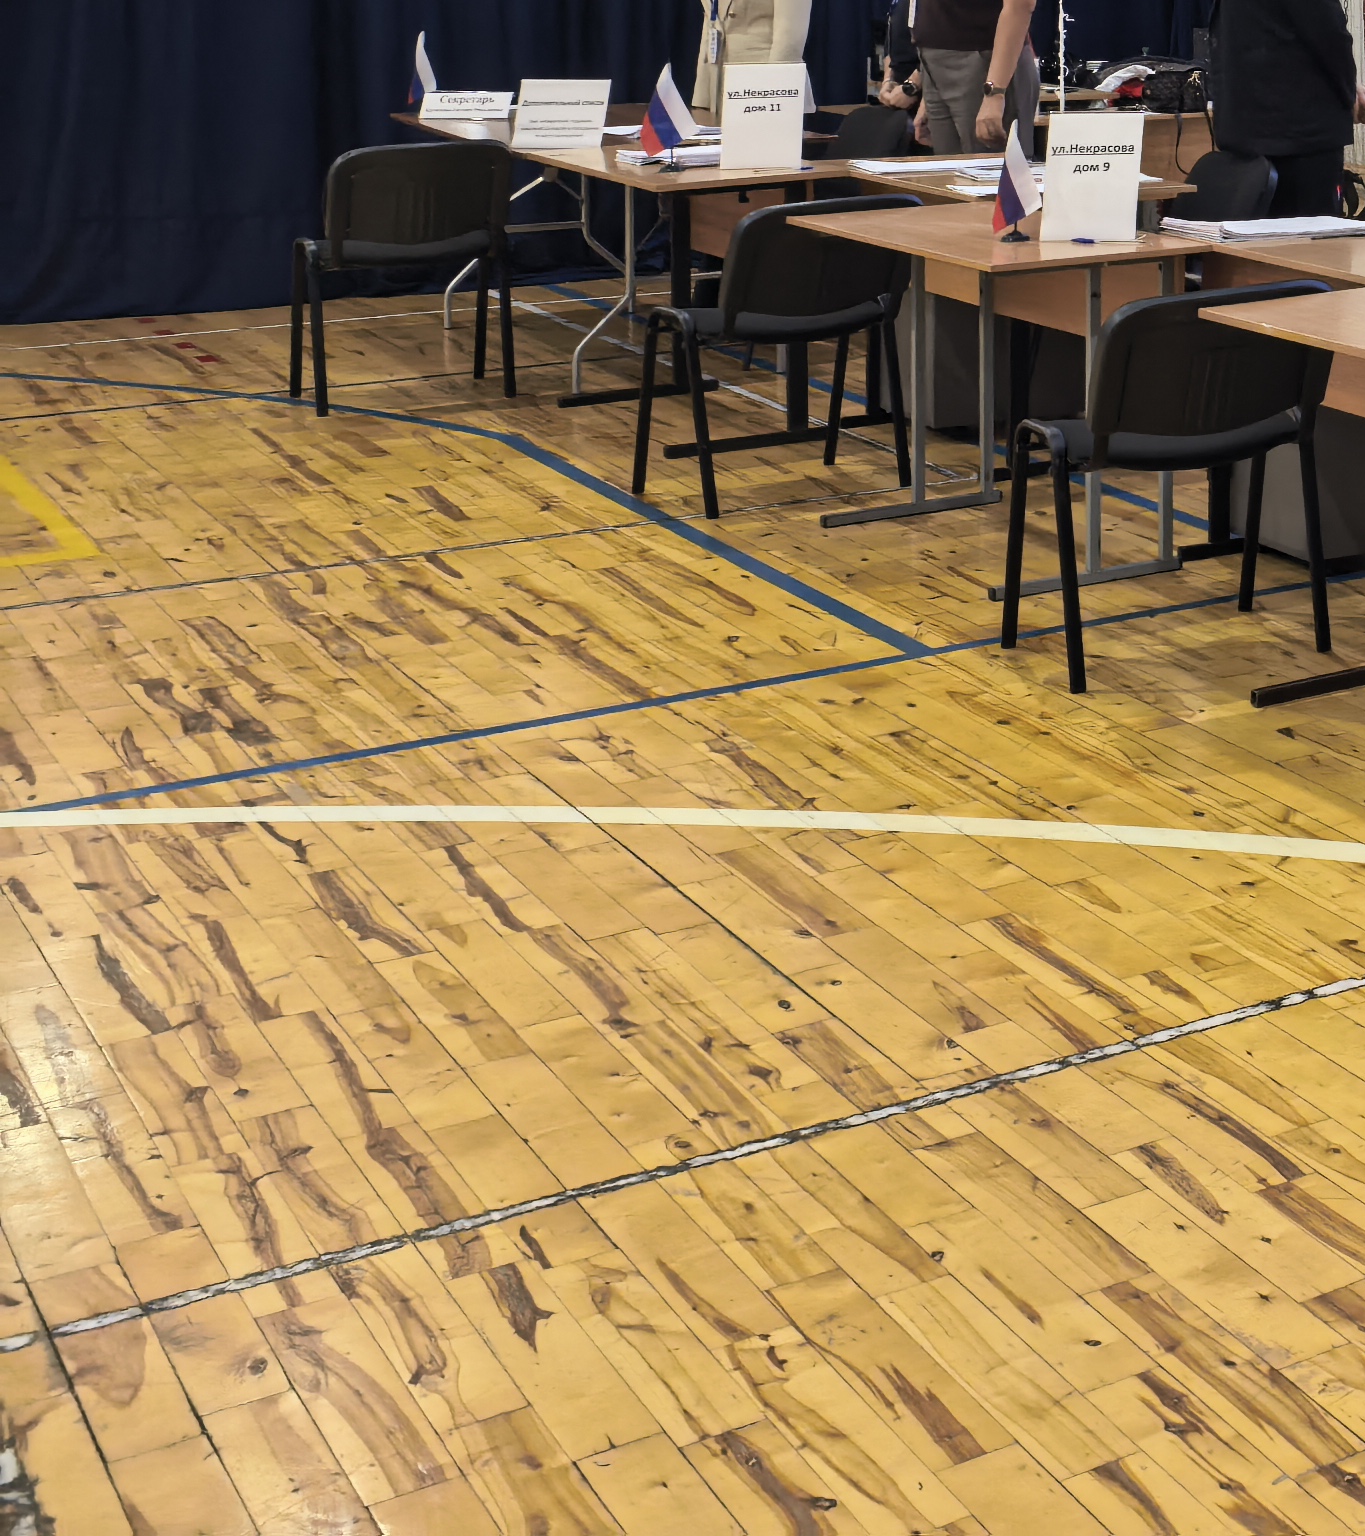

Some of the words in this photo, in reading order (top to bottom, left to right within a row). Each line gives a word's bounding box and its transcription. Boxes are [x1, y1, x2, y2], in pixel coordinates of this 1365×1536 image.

[727, 88, 799, 99] ул.Некрасова
[743, 105, 767, 114] дом
[1051, 143, 1135, 156] ул.Некрасова
[1073, 164, 1100, 175] дом
[1102, 161, 1111, 172] 9
